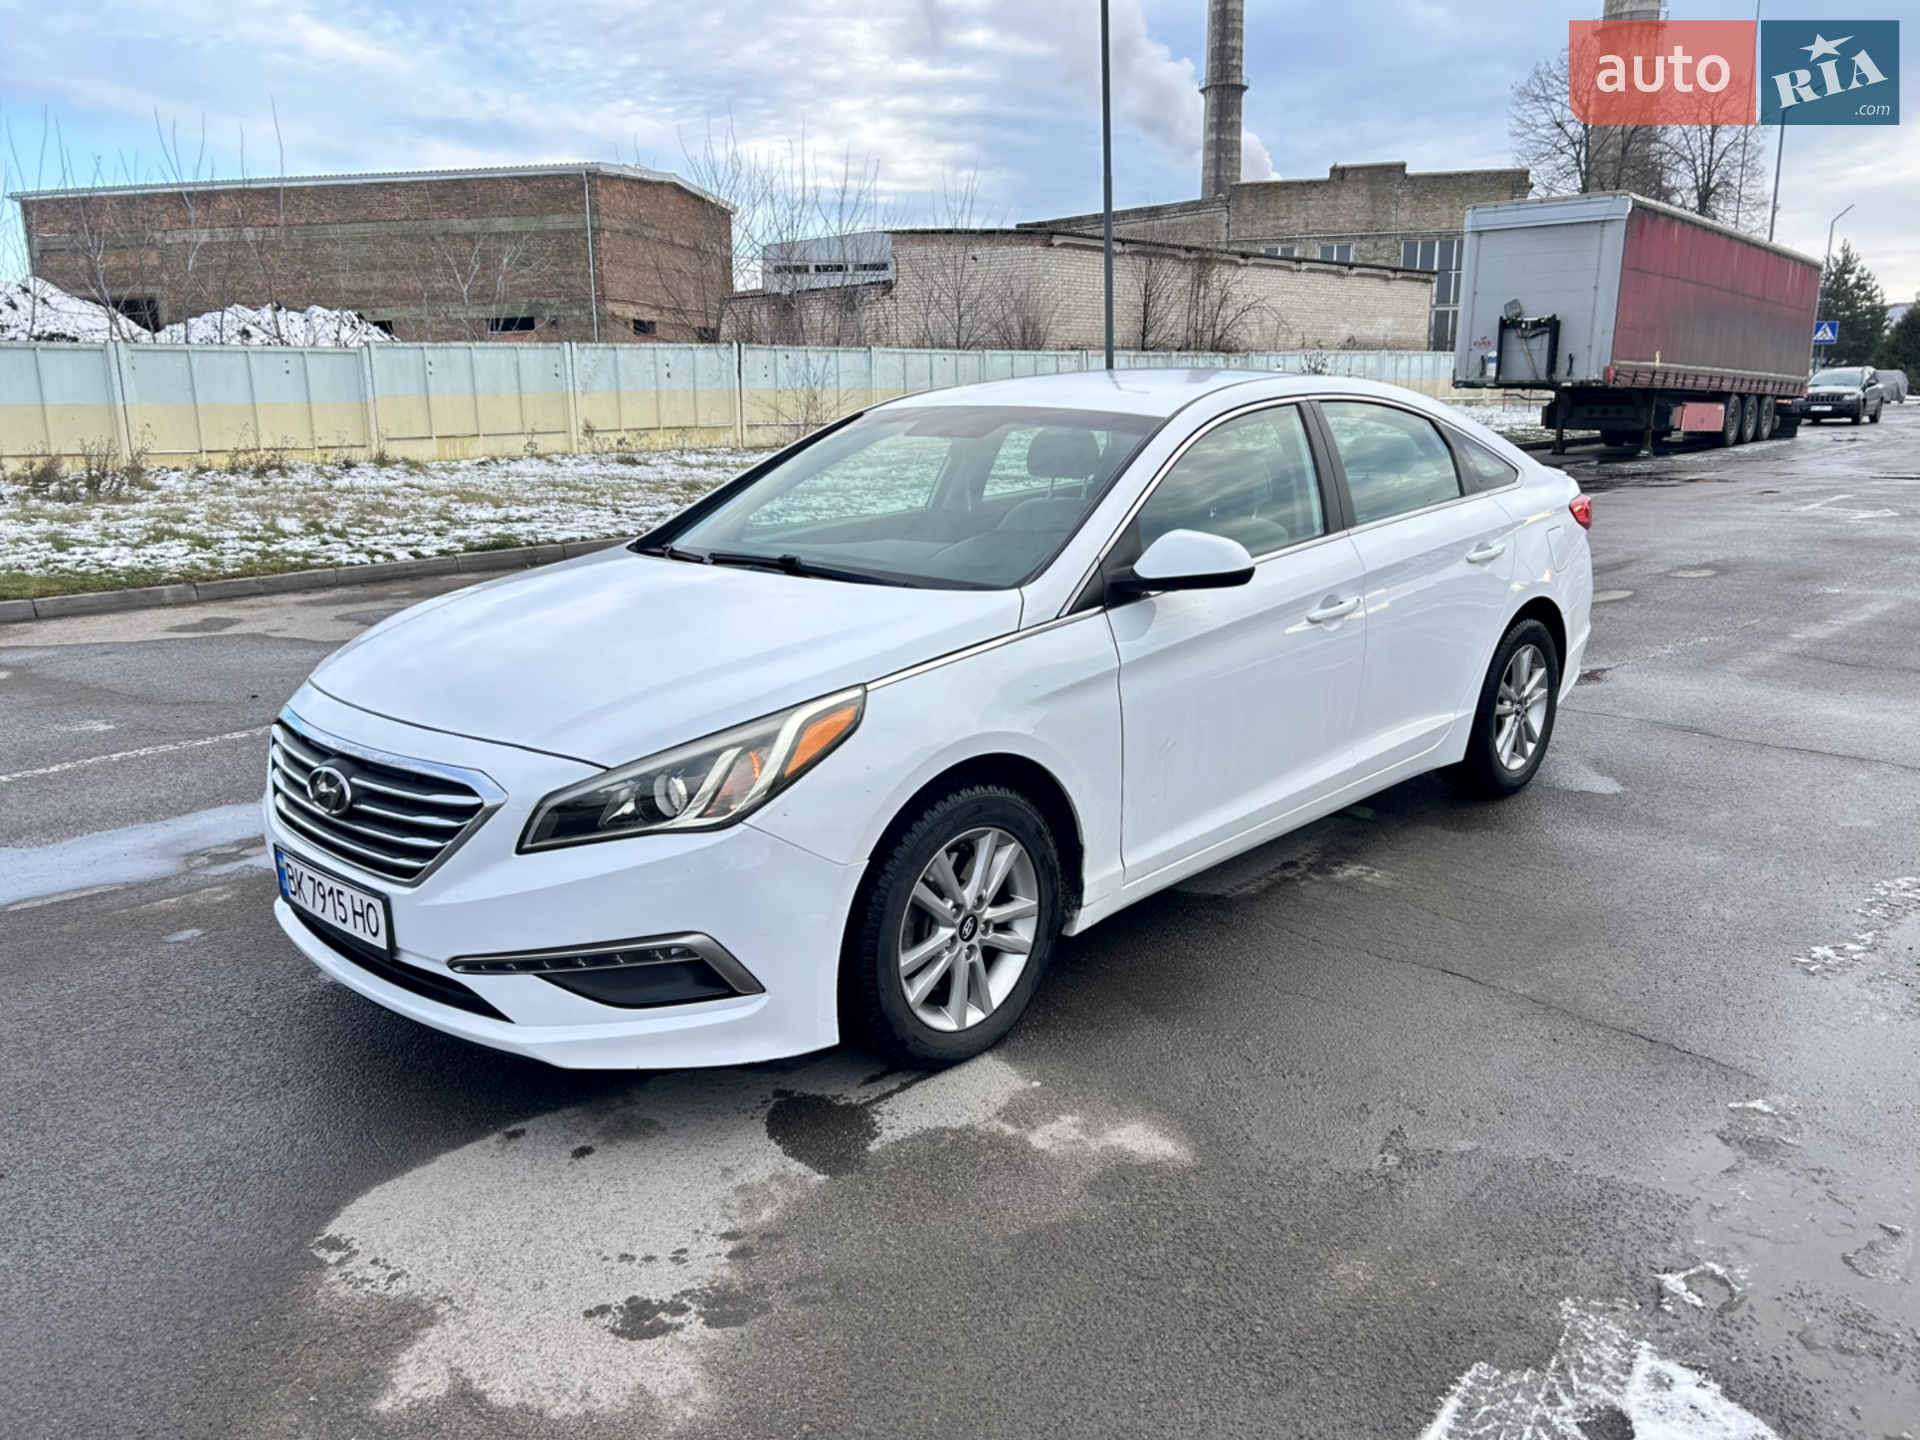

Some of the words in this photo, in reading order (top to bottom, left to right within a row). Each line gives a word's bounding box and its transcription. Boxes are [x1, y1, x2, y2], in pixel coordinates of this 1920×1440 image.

[286, 862, 308, 905] BK
[307, 875, 348, 925] 7915
[350, 894, 380, 938] HO
